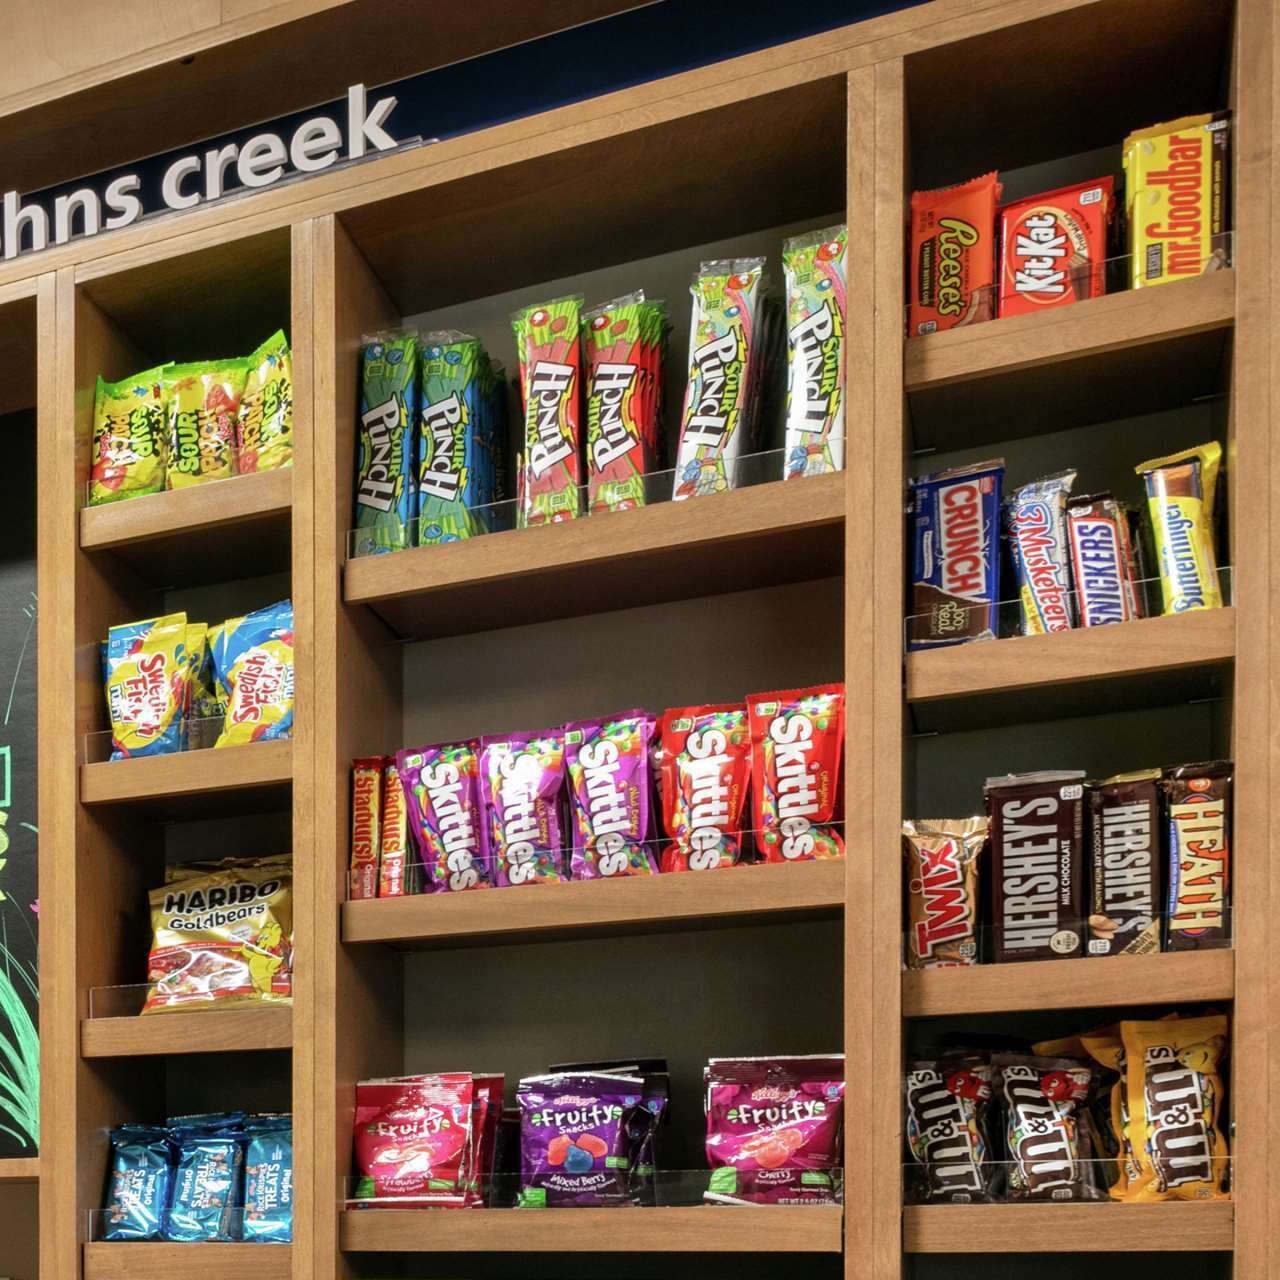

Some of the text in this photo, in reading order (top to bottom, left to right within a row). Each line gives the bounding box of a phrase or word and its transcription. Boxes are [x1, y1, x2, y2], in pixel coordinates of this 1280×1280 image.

[162, 83, 399, 211] creek
[531, 361, 575, 479] PUNCH
[593, 362, 637, 472] PUNCH
[682, 330, 739, 447] PUNCH
[787, 304, 834, 435] PUNCH
[358, 396, 399, 512] PUNCH
[420, 394, 460, 502] PUNCH
[943, 485, 982, 595] CRUNCH
[1077, 523, 1123, 627] SNICKERS
[578, 740, 628, 877] Skittles
[770, 712, 813, 861] Skittles
[164, 880, 280, 915] HARIBO
[169, 903, 266, 930] Goldbears
[1002, 796, 1059, 950] HERSHEY'S
[1061, 839, 1071, 906] MILK CHOCOLATE
